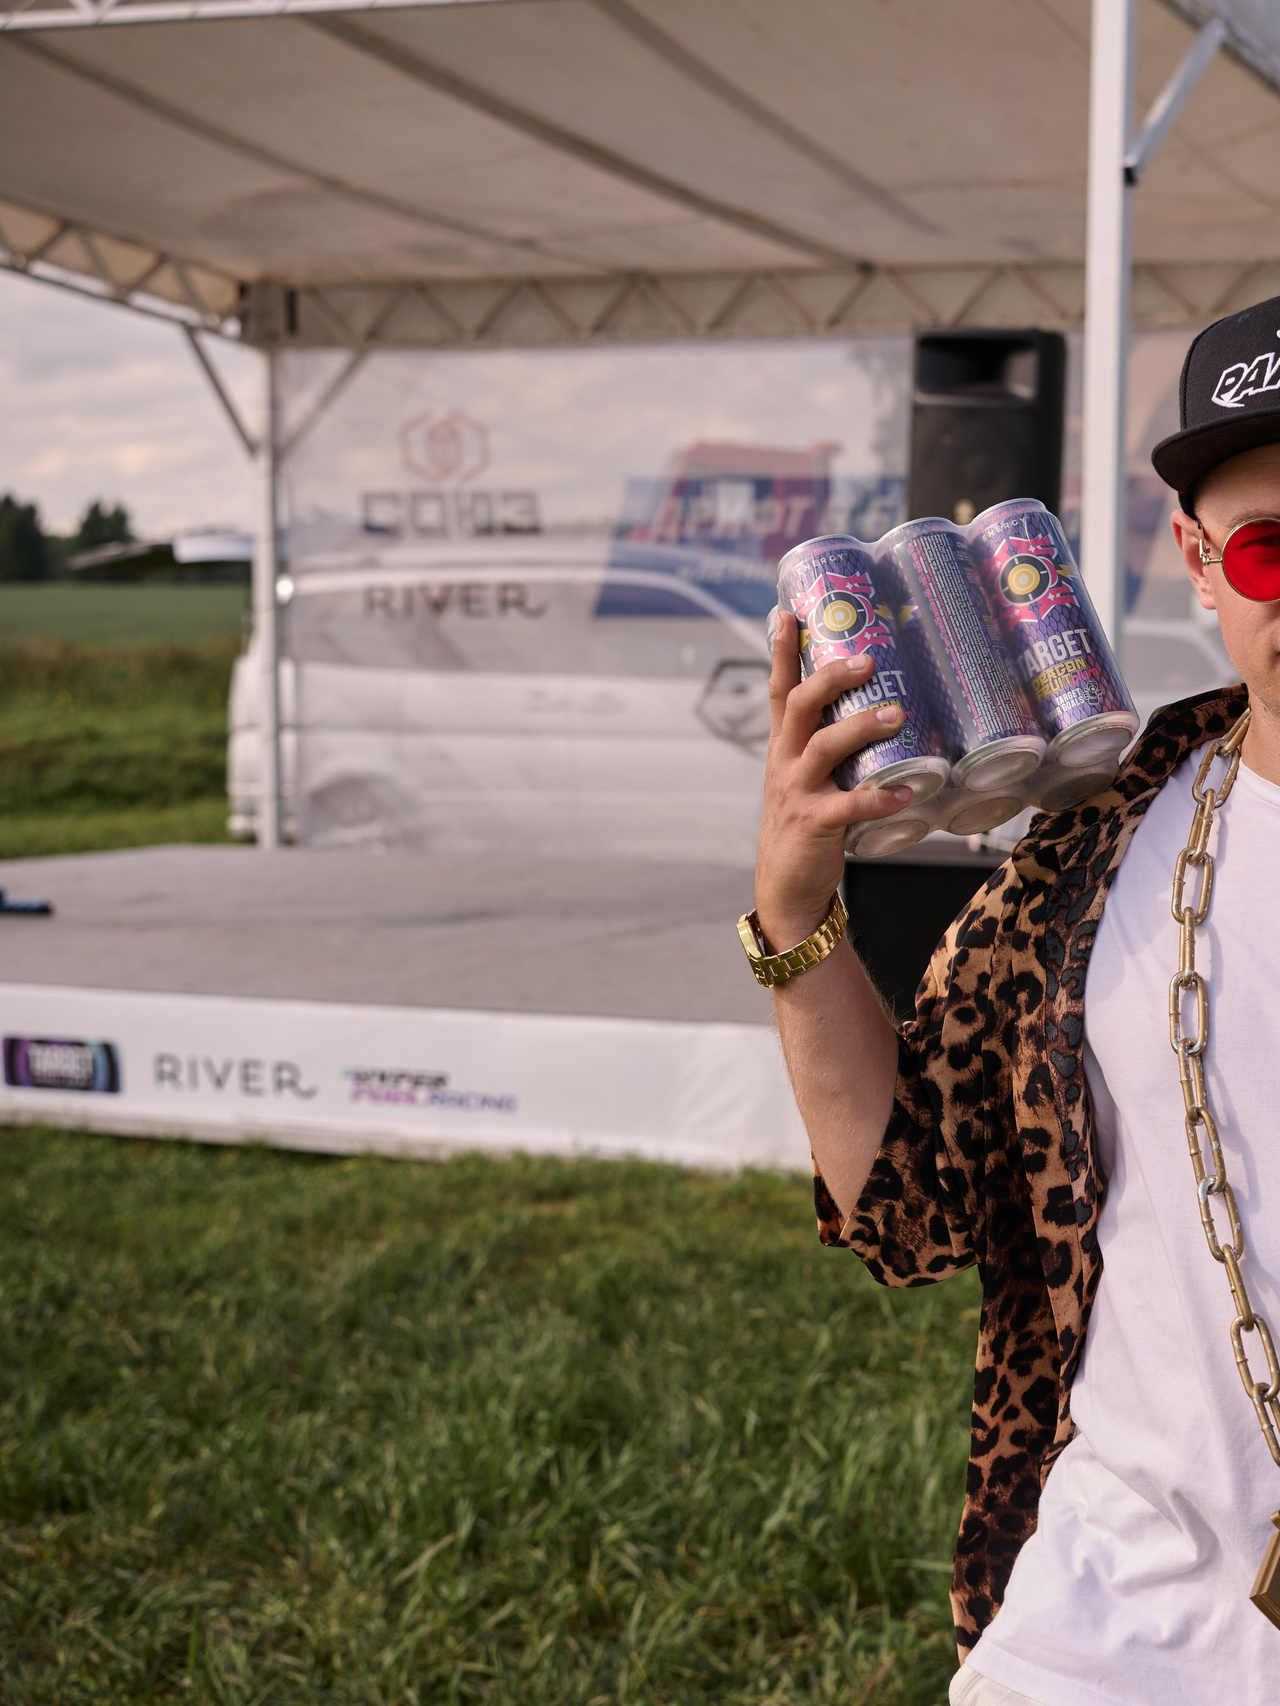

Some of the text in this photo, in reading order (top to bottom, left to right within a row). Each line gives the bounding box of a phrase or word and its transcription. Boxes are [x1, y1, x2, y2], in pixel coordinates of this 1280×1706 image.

[982, 517, 1027, 541] ENERGY
[797, 554, 845, 574] ENERGY
[362, 582, 549, 620] RIVER
[1017, 628, 1091, 682] TARGET
[1037, 667, 1099, 702] FRUIT plum
[1055, 687, 1081, 706] TARGET
[1062, 695, 1085, 712] GOALS
[857, 737, 900, 762] YOUR GOALS
[153, 1053, 319, 1100] RIVER
